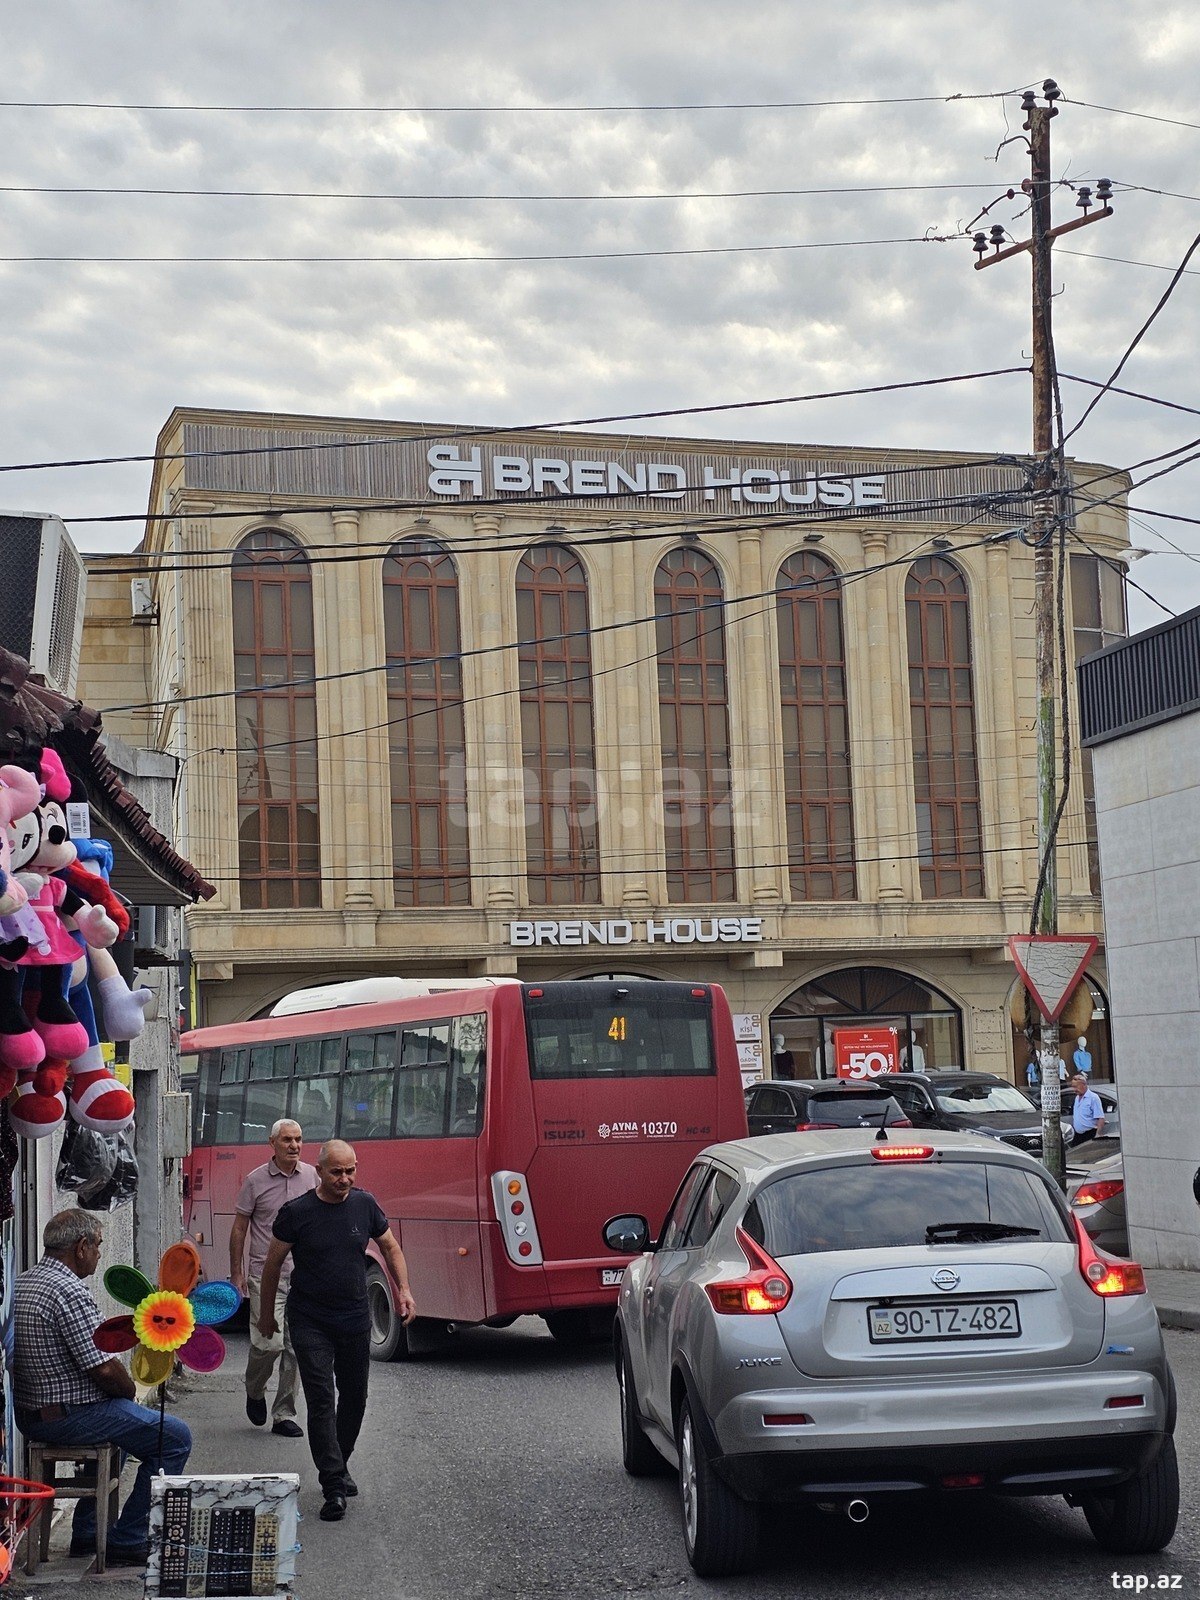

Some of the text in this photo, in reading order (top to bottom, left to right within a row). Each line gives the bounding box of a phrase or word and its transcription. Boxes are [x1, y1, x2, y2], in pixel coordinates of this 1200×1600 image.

[493, 455, 687, 500] BREND
[704, 466, 887, 507] HOUSE
[509, 918, 763, 946] BREND HOUSE
[608, 1017, 626, 1040] 41
[544, 1130, 586, 1140] ISUZU
[612, 1122, 638, 1131] AYNA
[641, 1121, 678, 1135] 10370
[877, 1323, 890, 1334] AZ
[893, 1306, 1013, 1335] 90-TZ-482
[735, 1356, 783, 1370] JUKE
